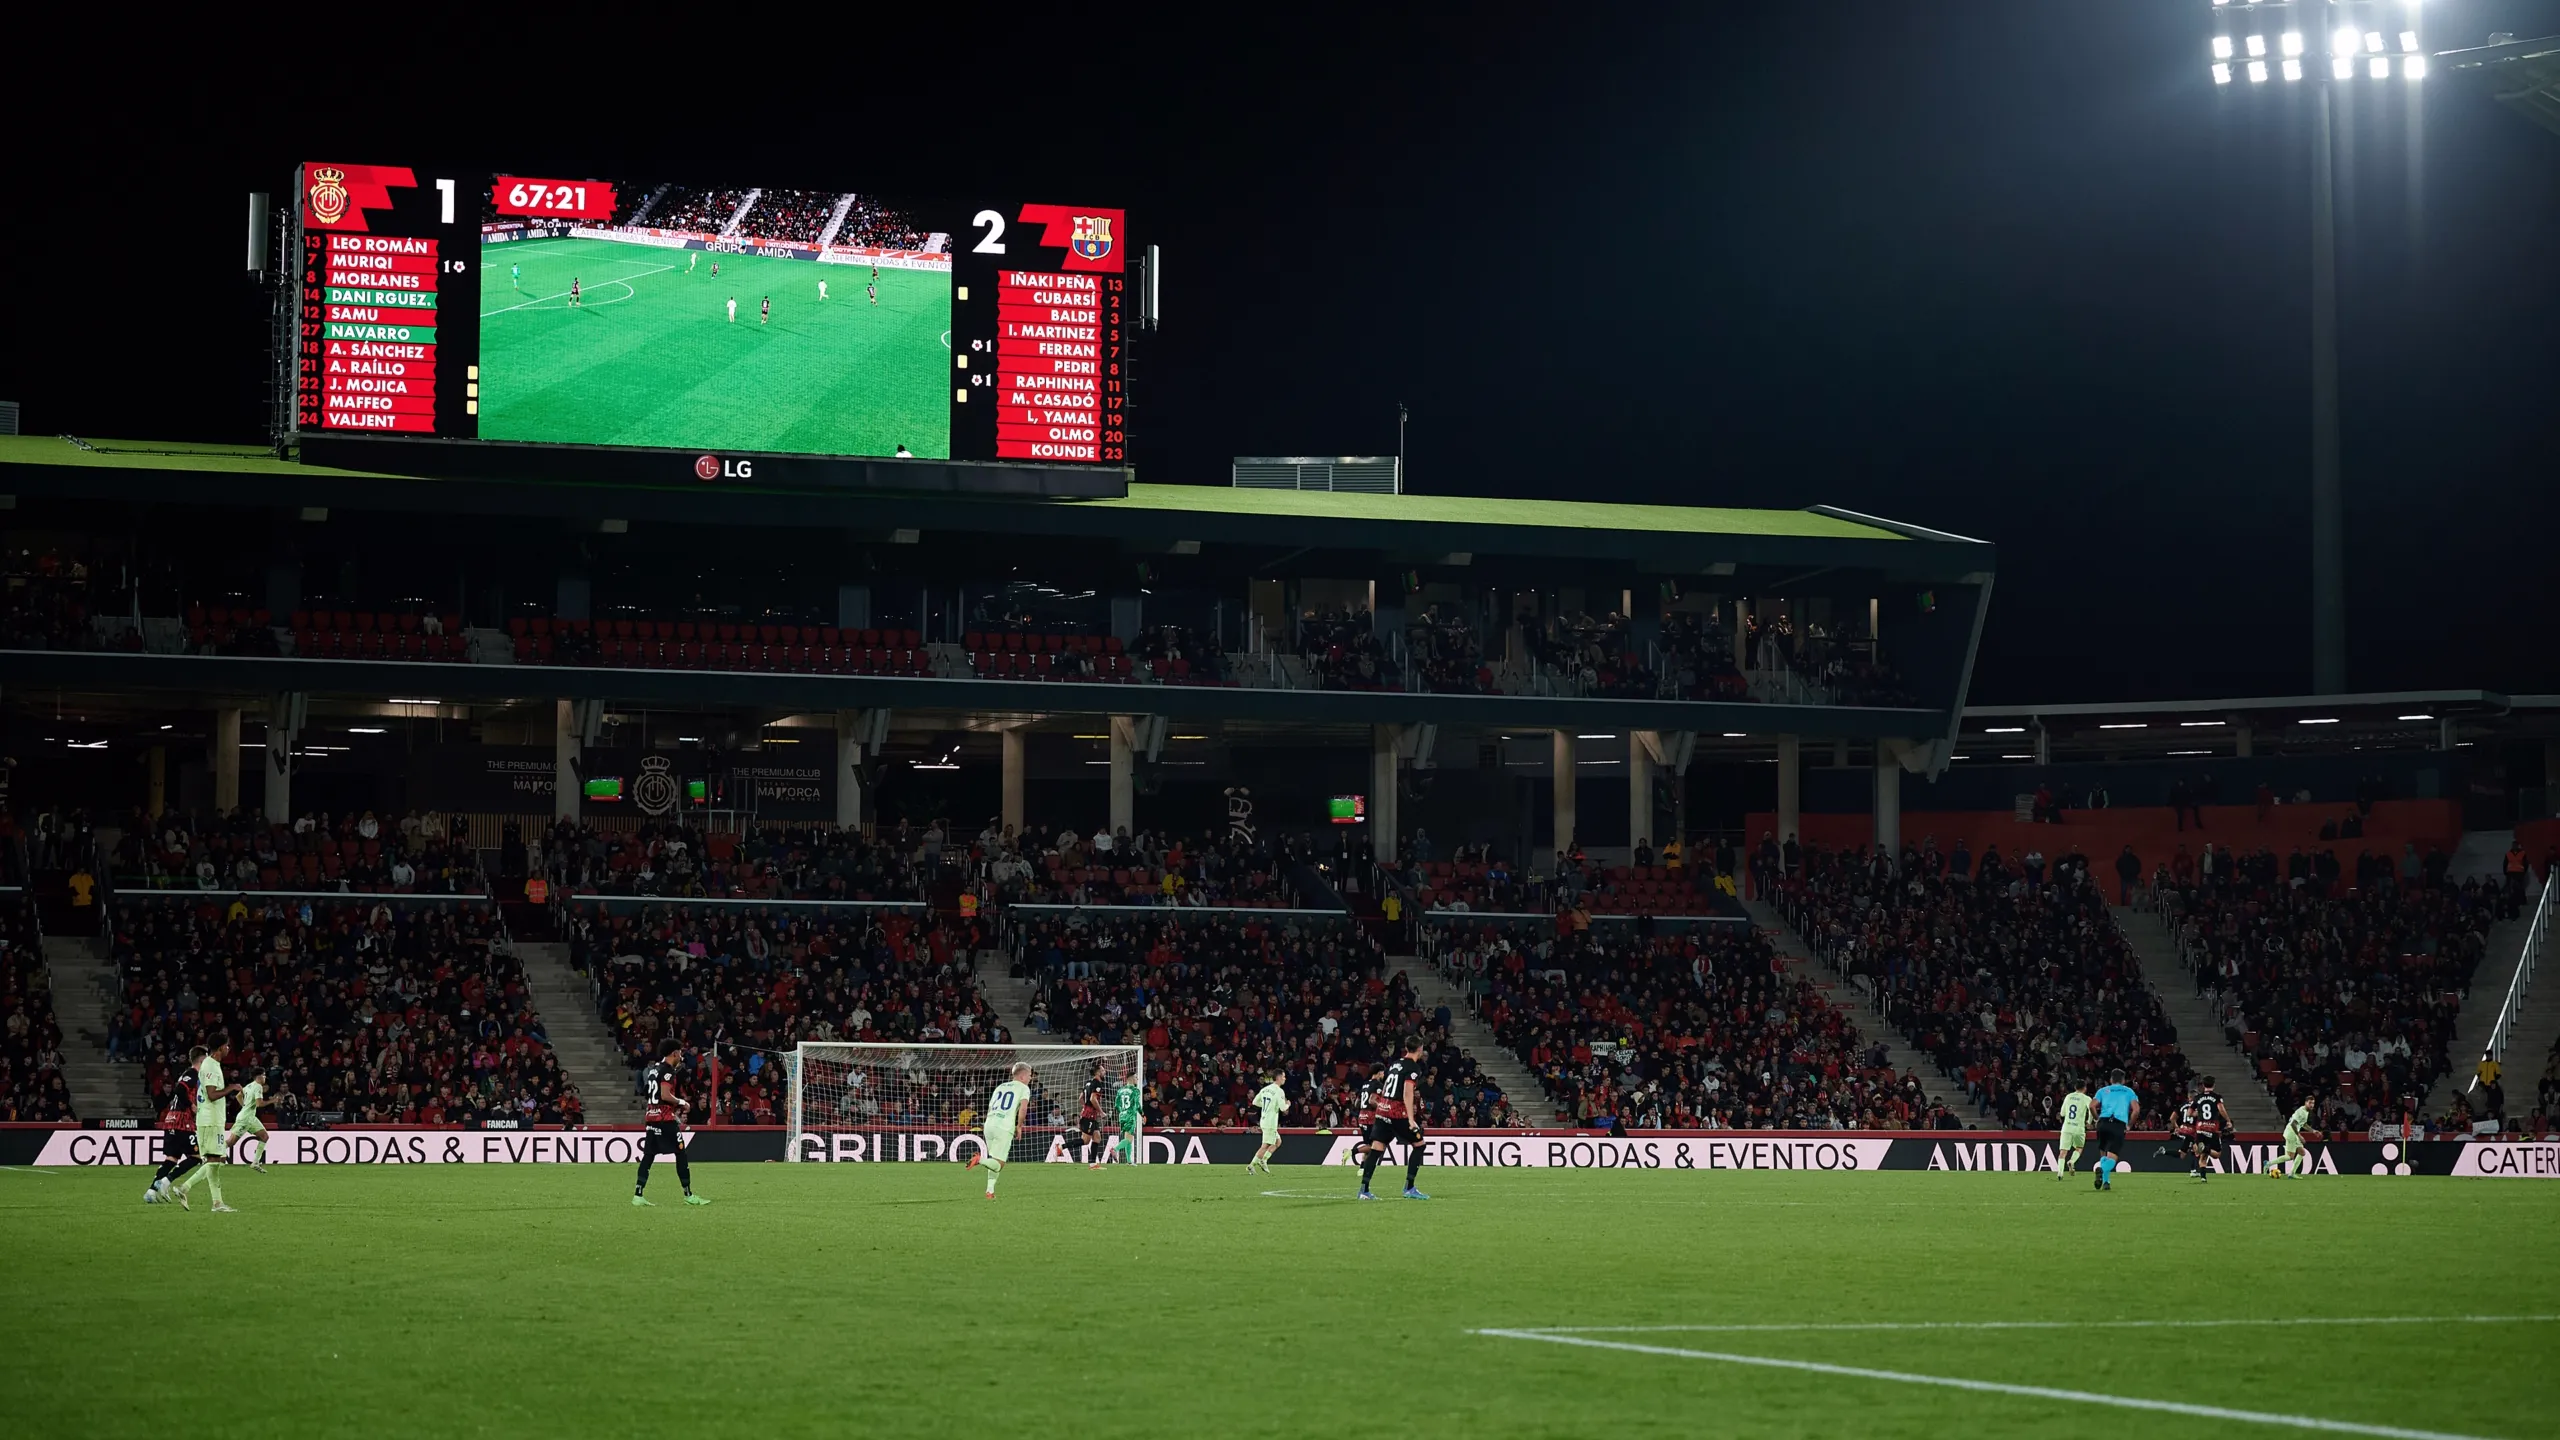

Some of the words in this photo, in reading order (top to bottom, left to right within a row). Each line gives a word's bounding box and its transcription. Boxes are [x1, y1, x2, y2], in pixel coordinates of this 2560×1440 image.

[436, 179, 455, 223] 1
[509, 184, 585, 211] 67:21
[488, 232, 509, 243] AMIDA
[527, 229, 548, 239] AMIDA
[973, 210, 1006, 254] 2
[304, 236, 321, 248] 13
[333, 237, 361, 250] LEO
[366, 237, 427, 253] ROMÁN
[706, 241, 747, 254] GRUPO
[756, 246, 794, 258] AMIDA
[308, 253, 317, 265] 7
[332, 255, 392, 269] MURIQI
[444, 260, 449, 272] 1
[871, 258, 900, 266] BODAS
[306, 271, 316, 283] 8
[332, 272, 419, 288] MORLANES
[1011, 272, 1053, 287] IÑAKI
[1057, 274, 1095, 289] PEÑA
[1108, 279, 1123, 291] 13
[303, 288, 320, 301] 14
[332, 290, 371, 303] DANI
[376, 292, 431, 306] RGUEZ.
[1034, 291, 1095, 306] CUBARSÍ
[1111, 296, 1120, 308] 2
[303, 306, 320, 319] 12
[331, 307, 378, 321] SAMU
[1051, 310, 1095, 323] BALDE
[1110, 313, 1120, 324] 3
[301, 323, 320, 337] 27
[331, 325, 410, 340] NAVARRO
[1009, 324, 1017, 336] I.
[1021, 325, 1095, 340] MARTINEZ
[1110, 330, 1119, 341] 5
[302, 341, 319, 354] 18
[331, 343, 346, 355] A.
[351, 340, 424, 360] SÁNCHEZ
[986, 340, 991, 352] 1
[1039, 343, 1095, 356] FERRAN
[1111, 347, 1120, 358] 7
[300, 359, 317, 372] 21
[330, 361, 346, 373] A.
[351, 359, 405, 376] RAÍLLO
[1055, 361, 1095, 374] PEDRI
[1110, 364, 1119, 375] 8
[299, 376, 319, 390] 22
[330, 378, 341, 391] J.
[347, 379, 407, 394] MOJICA
[986, 374, 991, 386] 1
[1017, 376, 1095, 391] RAPHINHA
[1108, 381, 1120, 392] 11
[299, 394, 319, 407] 23
[330, 396, 392, 410] MAFFEO
[1012, 393, 1030, 405] M.
[1034, 393, 1095, 408] CASADÓ
[1108, 397, 1122, 409] 17
[299, 412, 319, 425] 24
[329, 414, 395, 428] VALJENT
[1043, 411, 1095, 425] YAMAL
[1108, 414, 1122, 426] 19
[1049, 428, 1094, 441] OLMO
[1105, 431, 1123, 442] 20
[1031, 444, 1095, 458] KOUNDE
[1105, 448, 1123, 460] 23
[724, 460, 752, 477] LG
[487, 760, 506, 769] THE
[508, 761, 551, 771] PREMIUM
[732, 767, 749, 776] THE
[752, 768, 794, 777] PREMIUM
[796, 769, 820, 778] CLUB
[1383, 1074, 1399, 1098] 21
[992, 1091, 1014, 1110] 20
[1121, 1095, 1130, 1110] 13
[1263, 1097, 1272, 1112] 17
[1360, 1091, 1369, 1109] 12
[2069, 1105, 2077, 1119] 8
[2202, 1103, 2212, 1120] 8
[99, 1119, 138, 1129] #FANCAM
[481, 1119, 519, 1129] #FANCAM
[189, 1135, 198, 1145] 2
[217, 1133, 225, 1145] 19
[69, 1135, 279, 1165] CATEG,
[300, 1136, 427, 1165] BODAS
[442, 1136, 465, 1165] &
[799, 1133, 989, 1163] GRUPO
[1550, 1143, 1660, 1169] BODAS
[1675, 1143, 1694, 1169] &
[1710, 1144, 1859, 1170] EVENTOS
[1927, 1142, 2059, 1172] AMIDA
